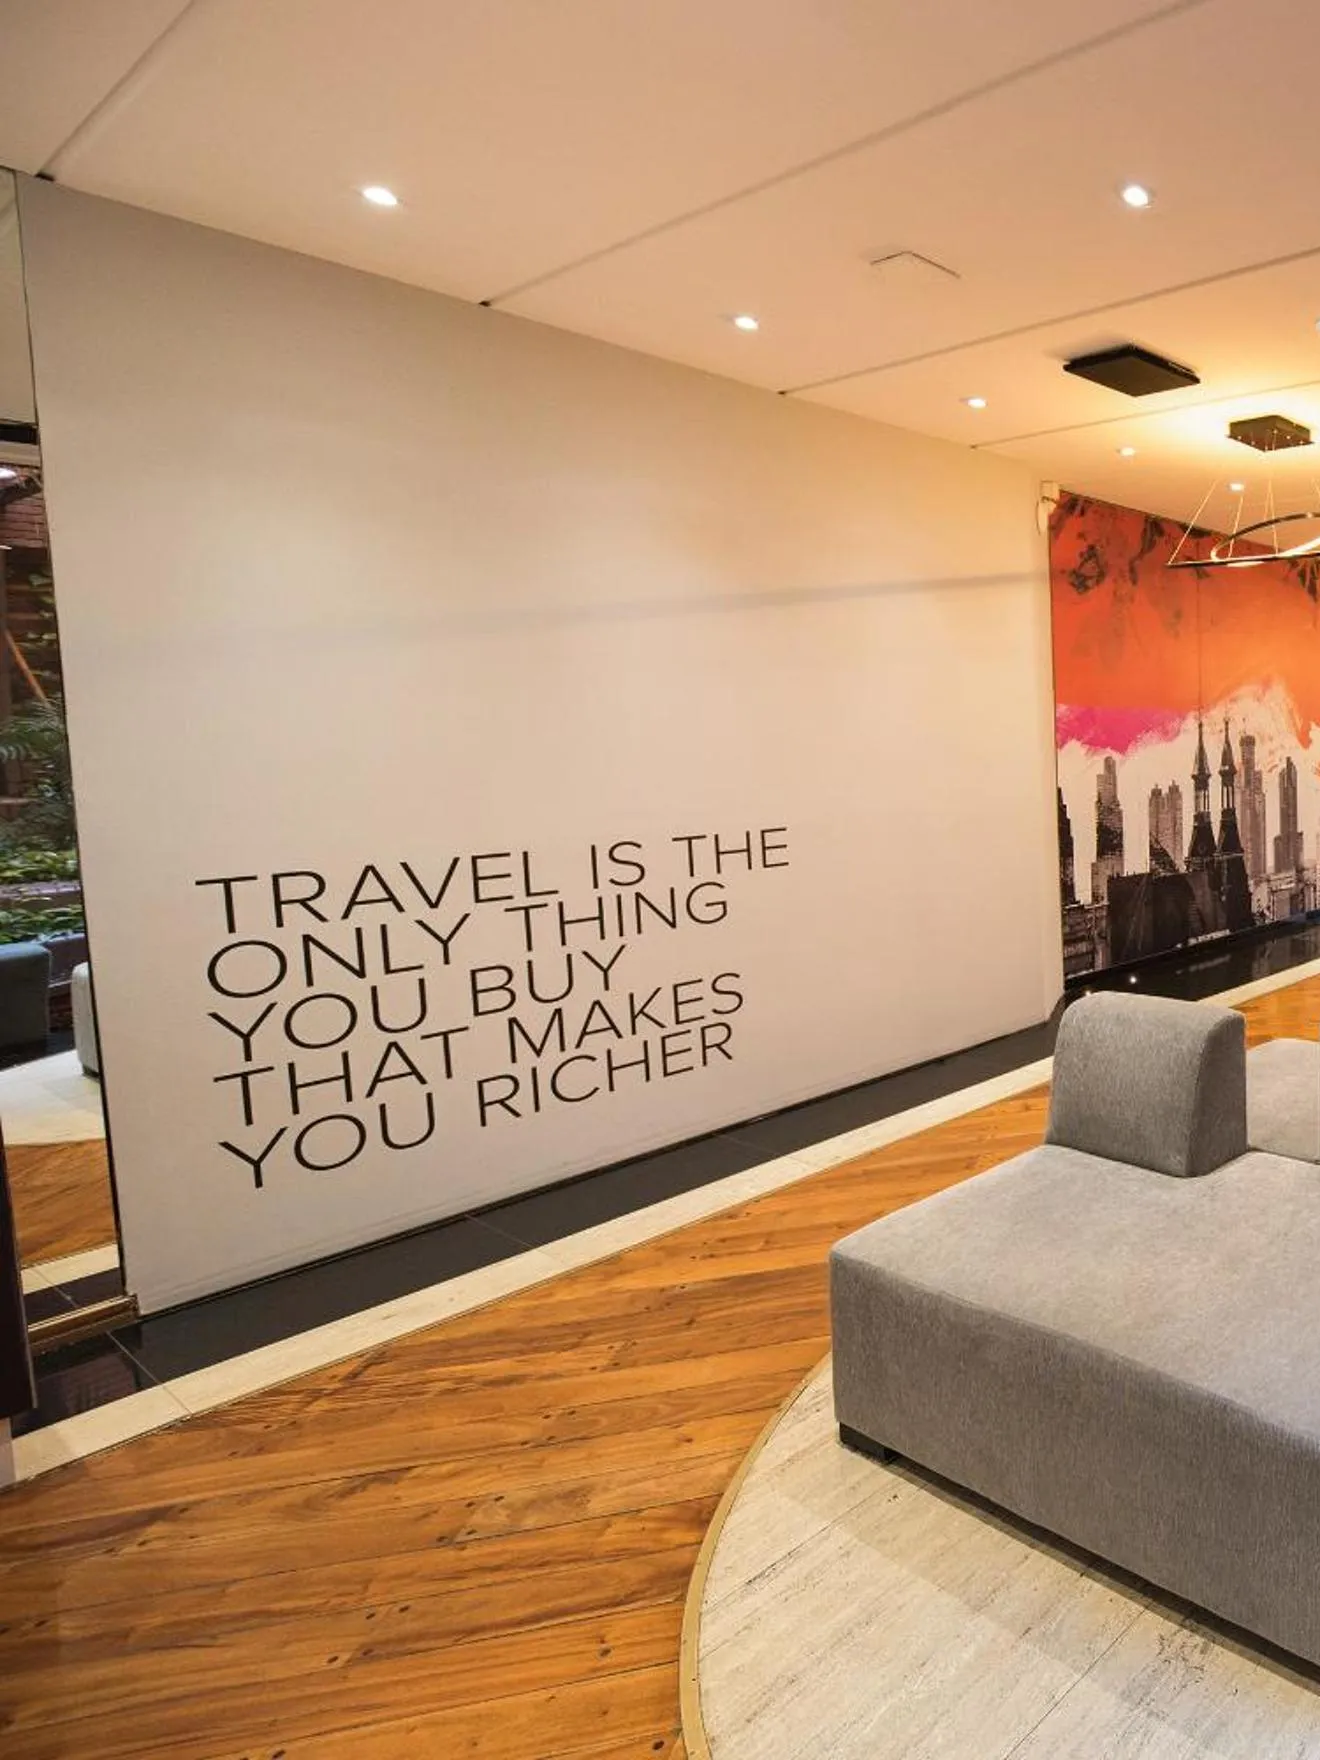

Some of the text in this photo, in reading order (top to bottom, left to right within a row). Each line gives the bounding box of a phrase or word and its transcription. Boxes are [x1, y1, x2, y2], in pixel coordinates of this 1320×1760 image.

[195, 828, 789, 933] TRAVEL IS THE
[208, 882, 728, 998] ONLY THING
[208, 945, 626, 1062] YOU BUY
[213, 973, 744, 1126] THAT MAKES
[218, 1023, 733, 1188] YOU RICHER
